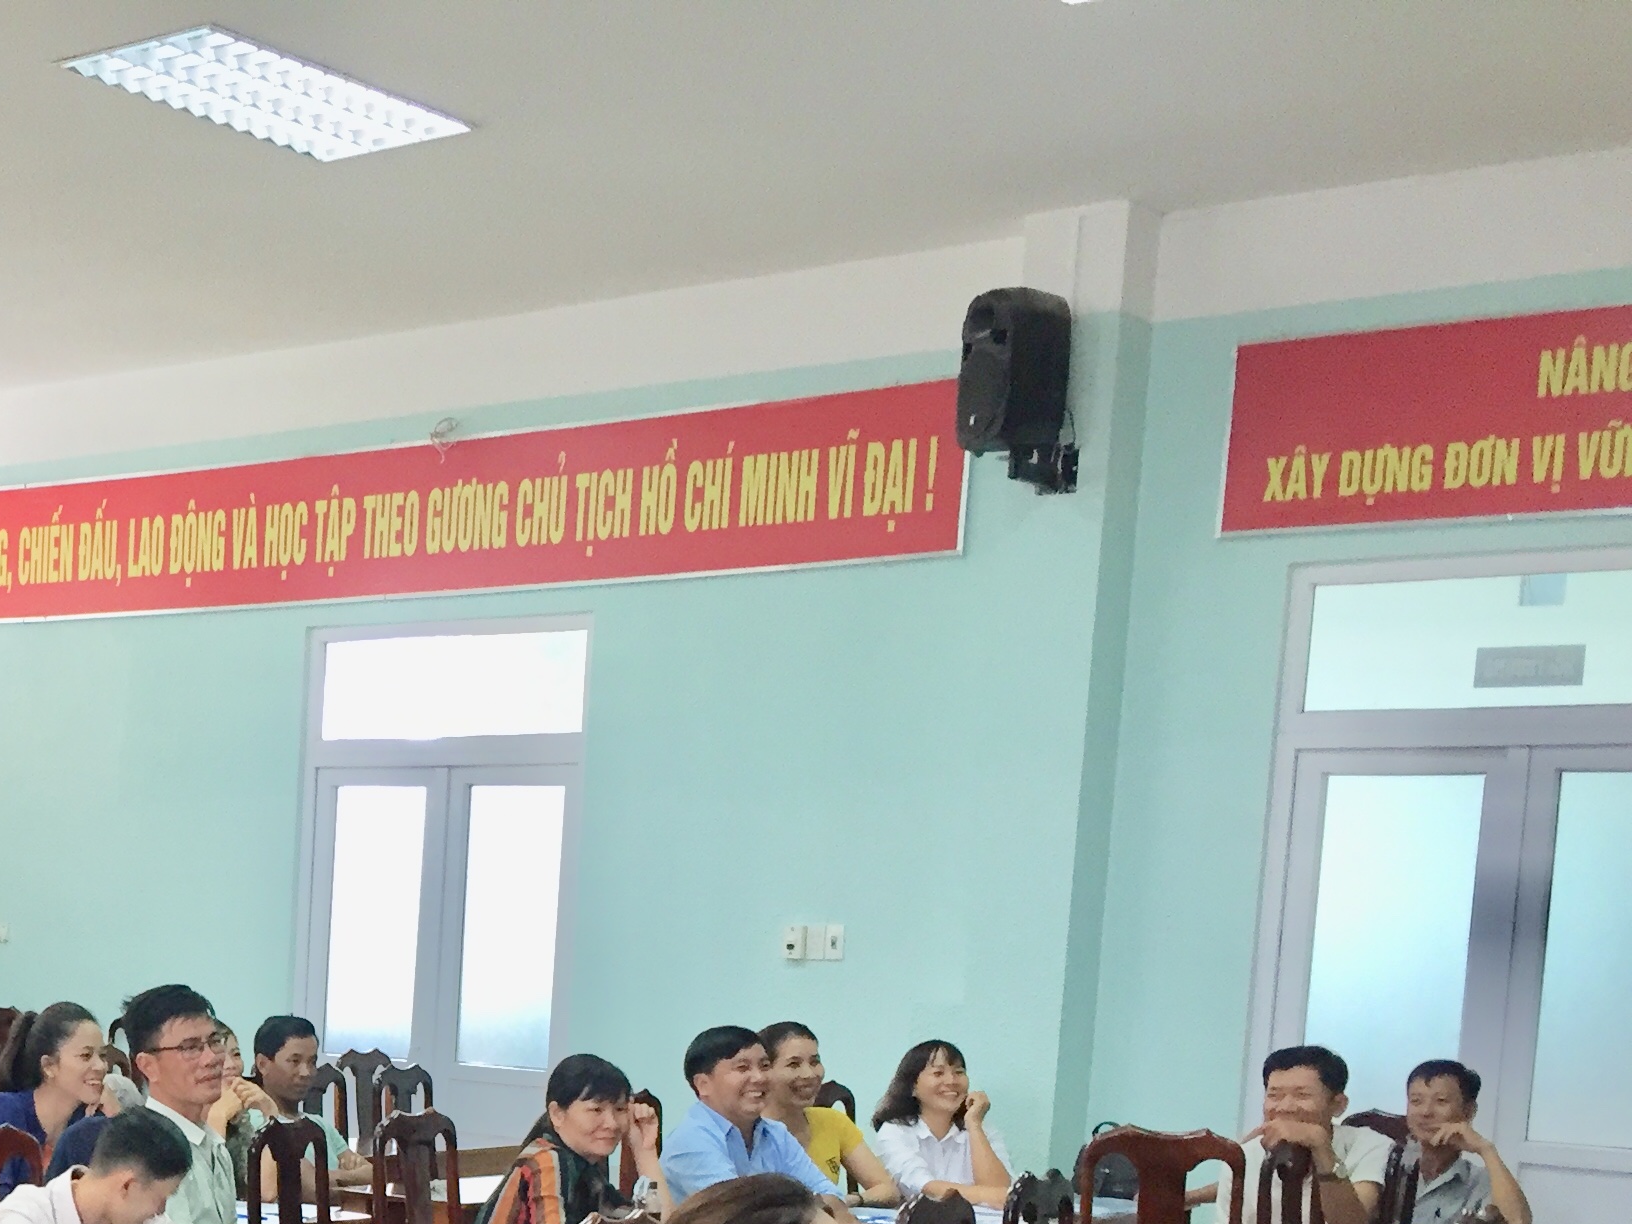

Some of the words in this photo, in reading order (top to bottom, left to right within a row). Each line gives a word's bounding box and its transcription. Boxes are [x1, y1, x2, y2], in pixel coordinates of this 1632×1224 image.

[17, 506, 73, 585] CHIẾN
[78, 499, 122, 587] ĐẤU,
[127, 514, 165, 579] LAO
[169, 500, 227, 587] ĐỘNG
[232, 493, 257, 569] VÀ
[264, 500, 308, 580] HỌC
[315, 485, 358, 577] TẬP
[363, 489, 421, 558] THEO
[426, 478, 510, 555] GƯƠNG
[515, 450, 569, 547] CHỦ
[575, 468, 634, 557] TỊCH
[639, 437, 678, 535] HỒ
[684, 441, 736, 533] CHÍ
[738, 448, 819, 527] MINH
[827, 428, 859, 520] VĨ
[863, 437, 918, 532] ĐẠI
[925, 435, 939, 511] !
[1262, 444, 1332, 502] XÂY
[1337, 443, 1434, 506] DỰNG
[1443, 434, 1521, 490] ĐƠN
[1531, 432, 1566, 494] VỊ
